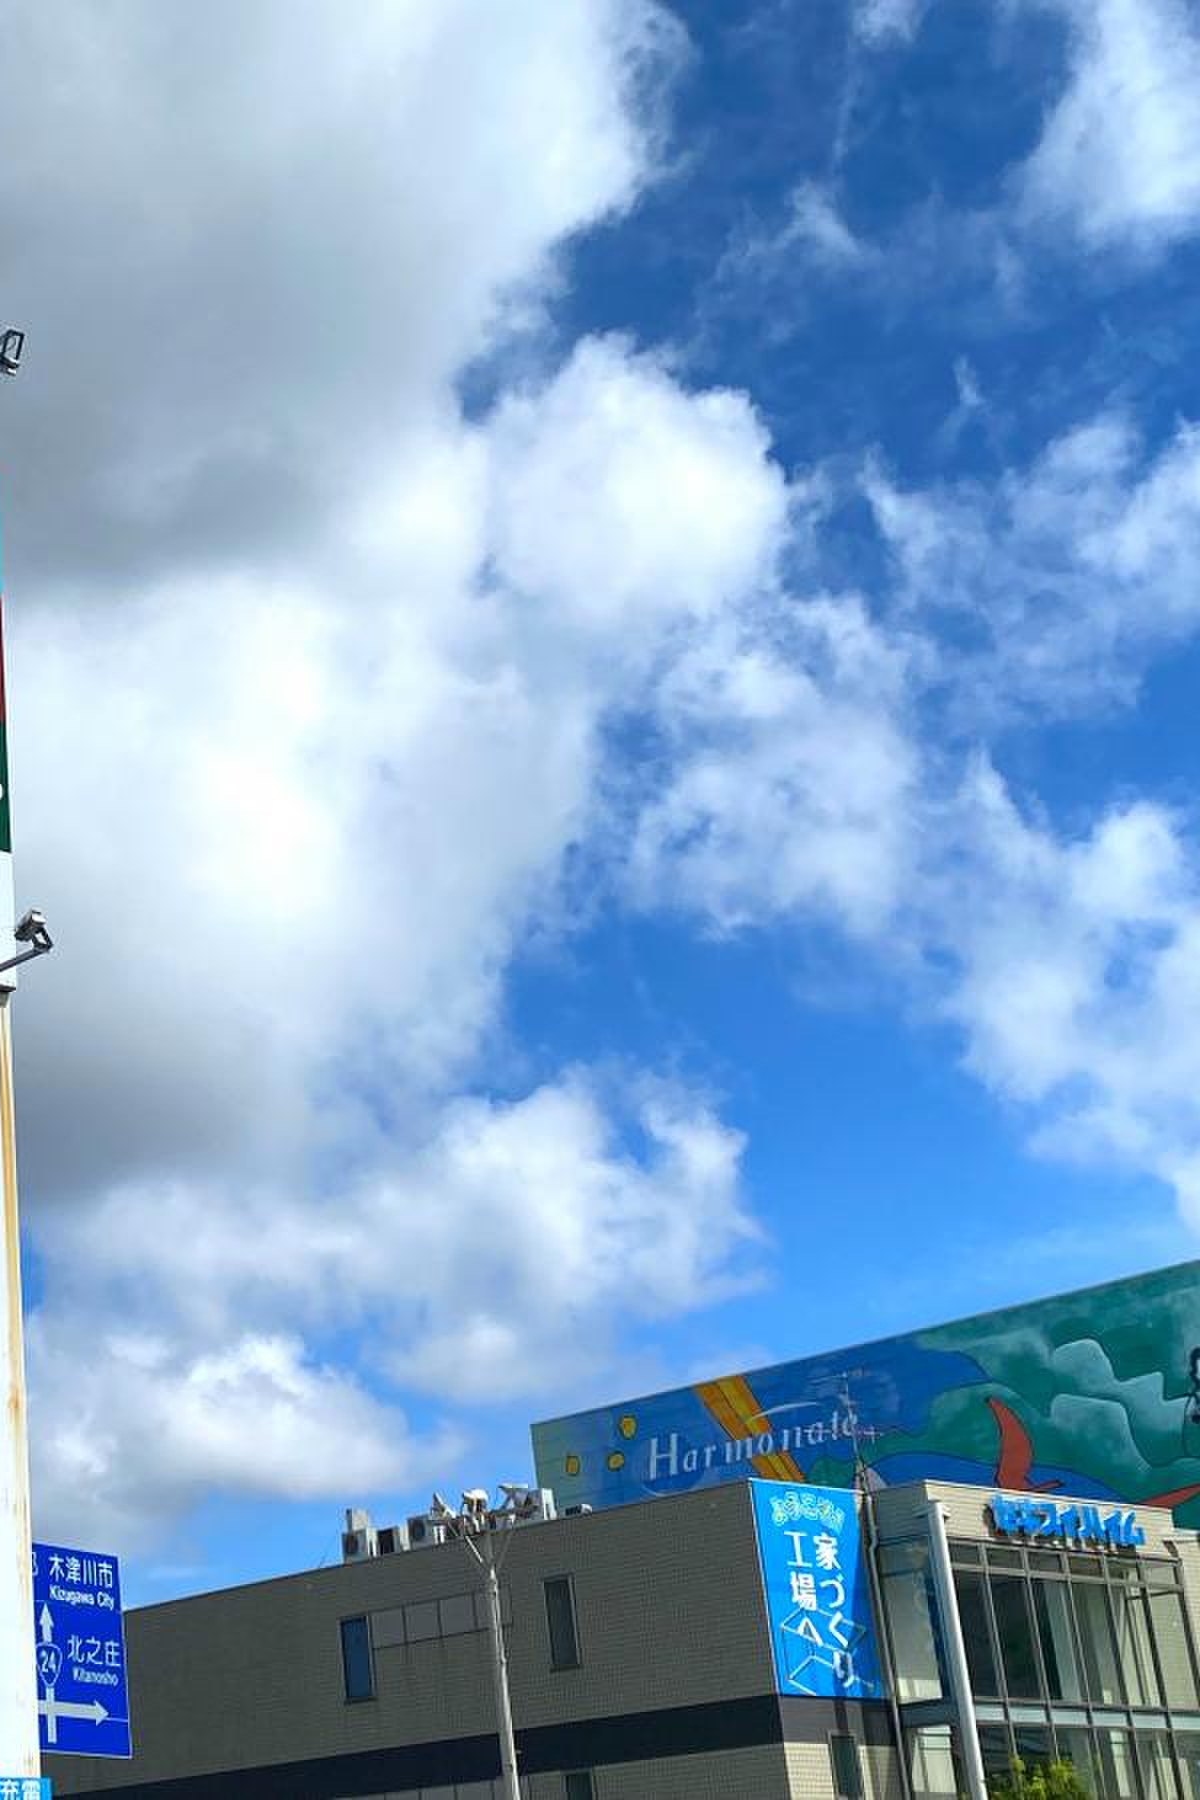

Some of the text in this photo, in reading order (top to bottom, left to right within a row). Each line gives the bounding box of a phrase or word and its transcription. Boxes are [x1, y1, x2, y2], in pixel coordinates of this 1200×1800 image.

[48, 1554, 113, 1588] 木津川市
[783, 1531, 823, 1647] 工場へ
[813, 1532, 855, 1688] 家づくり
[41, 1649, 57, 1674] 24
[67, 1634, 121, 1667] 北之庄
